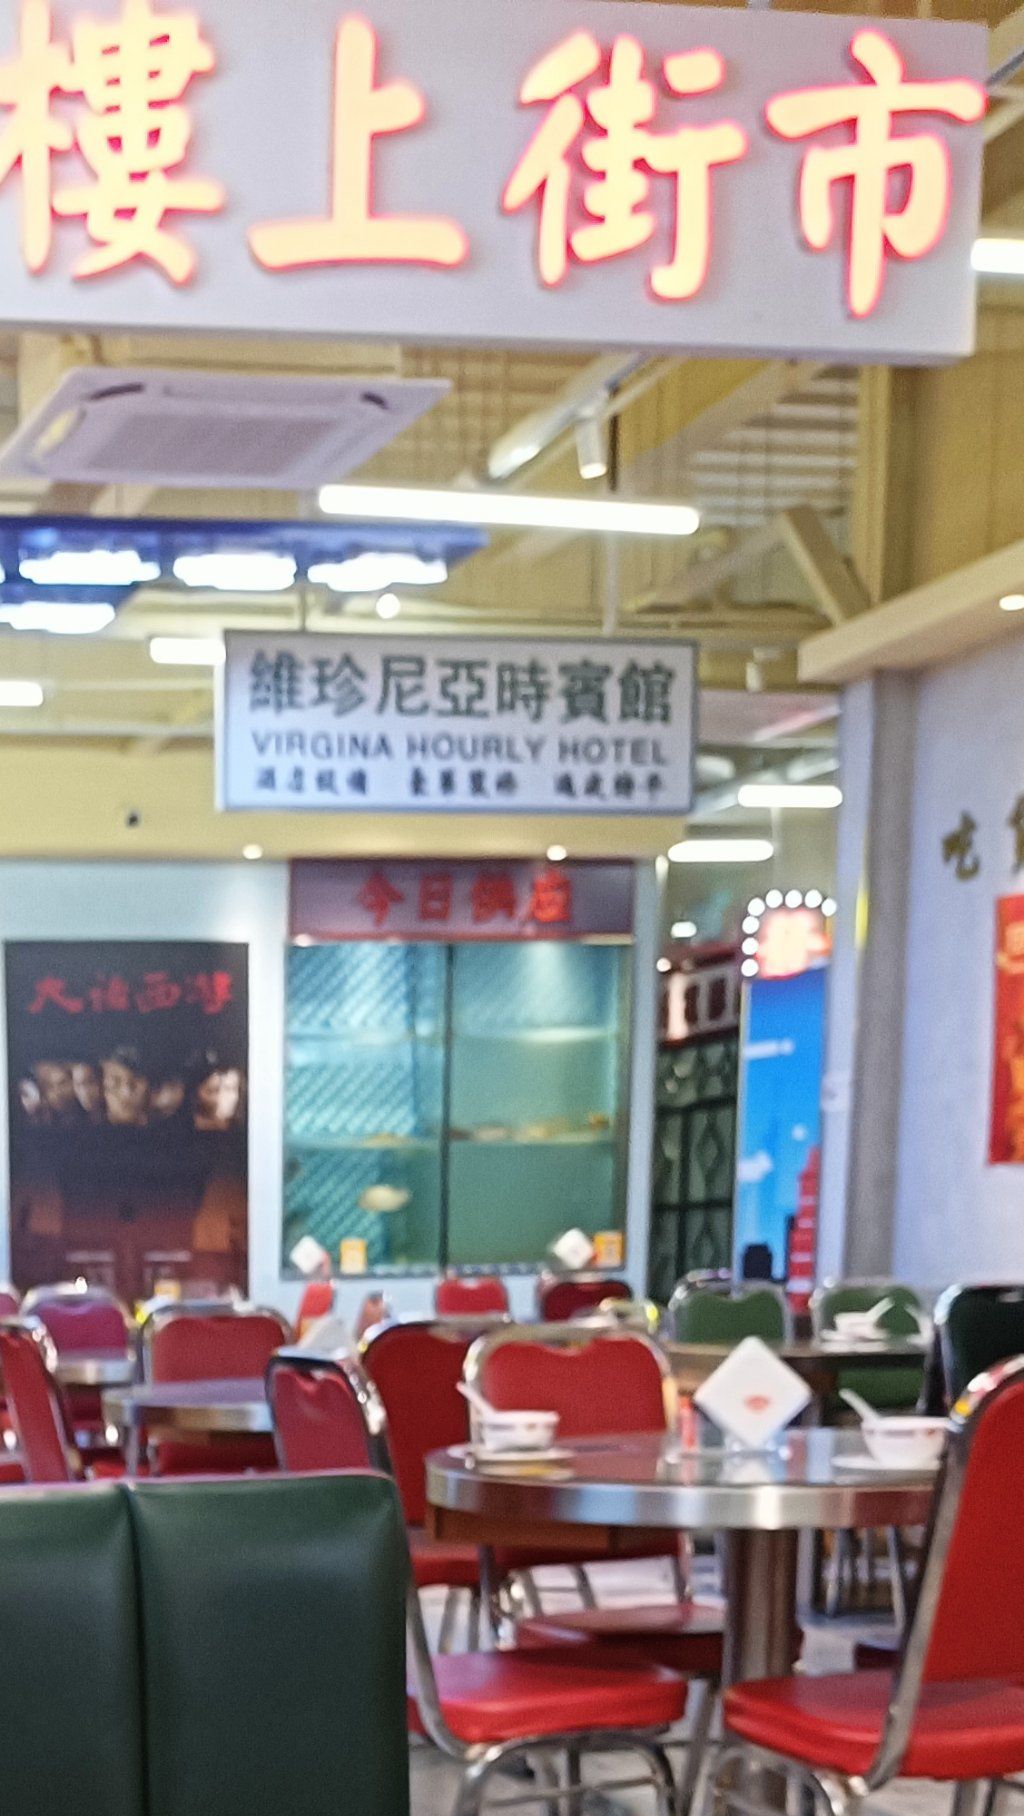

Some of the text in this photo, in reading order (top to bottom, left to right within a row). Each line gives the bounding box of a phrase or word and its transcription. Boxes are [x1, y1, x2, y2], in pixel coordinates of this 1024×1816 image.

[252, 730, 668, 767] VIRGINA HOURLY HOTEL
